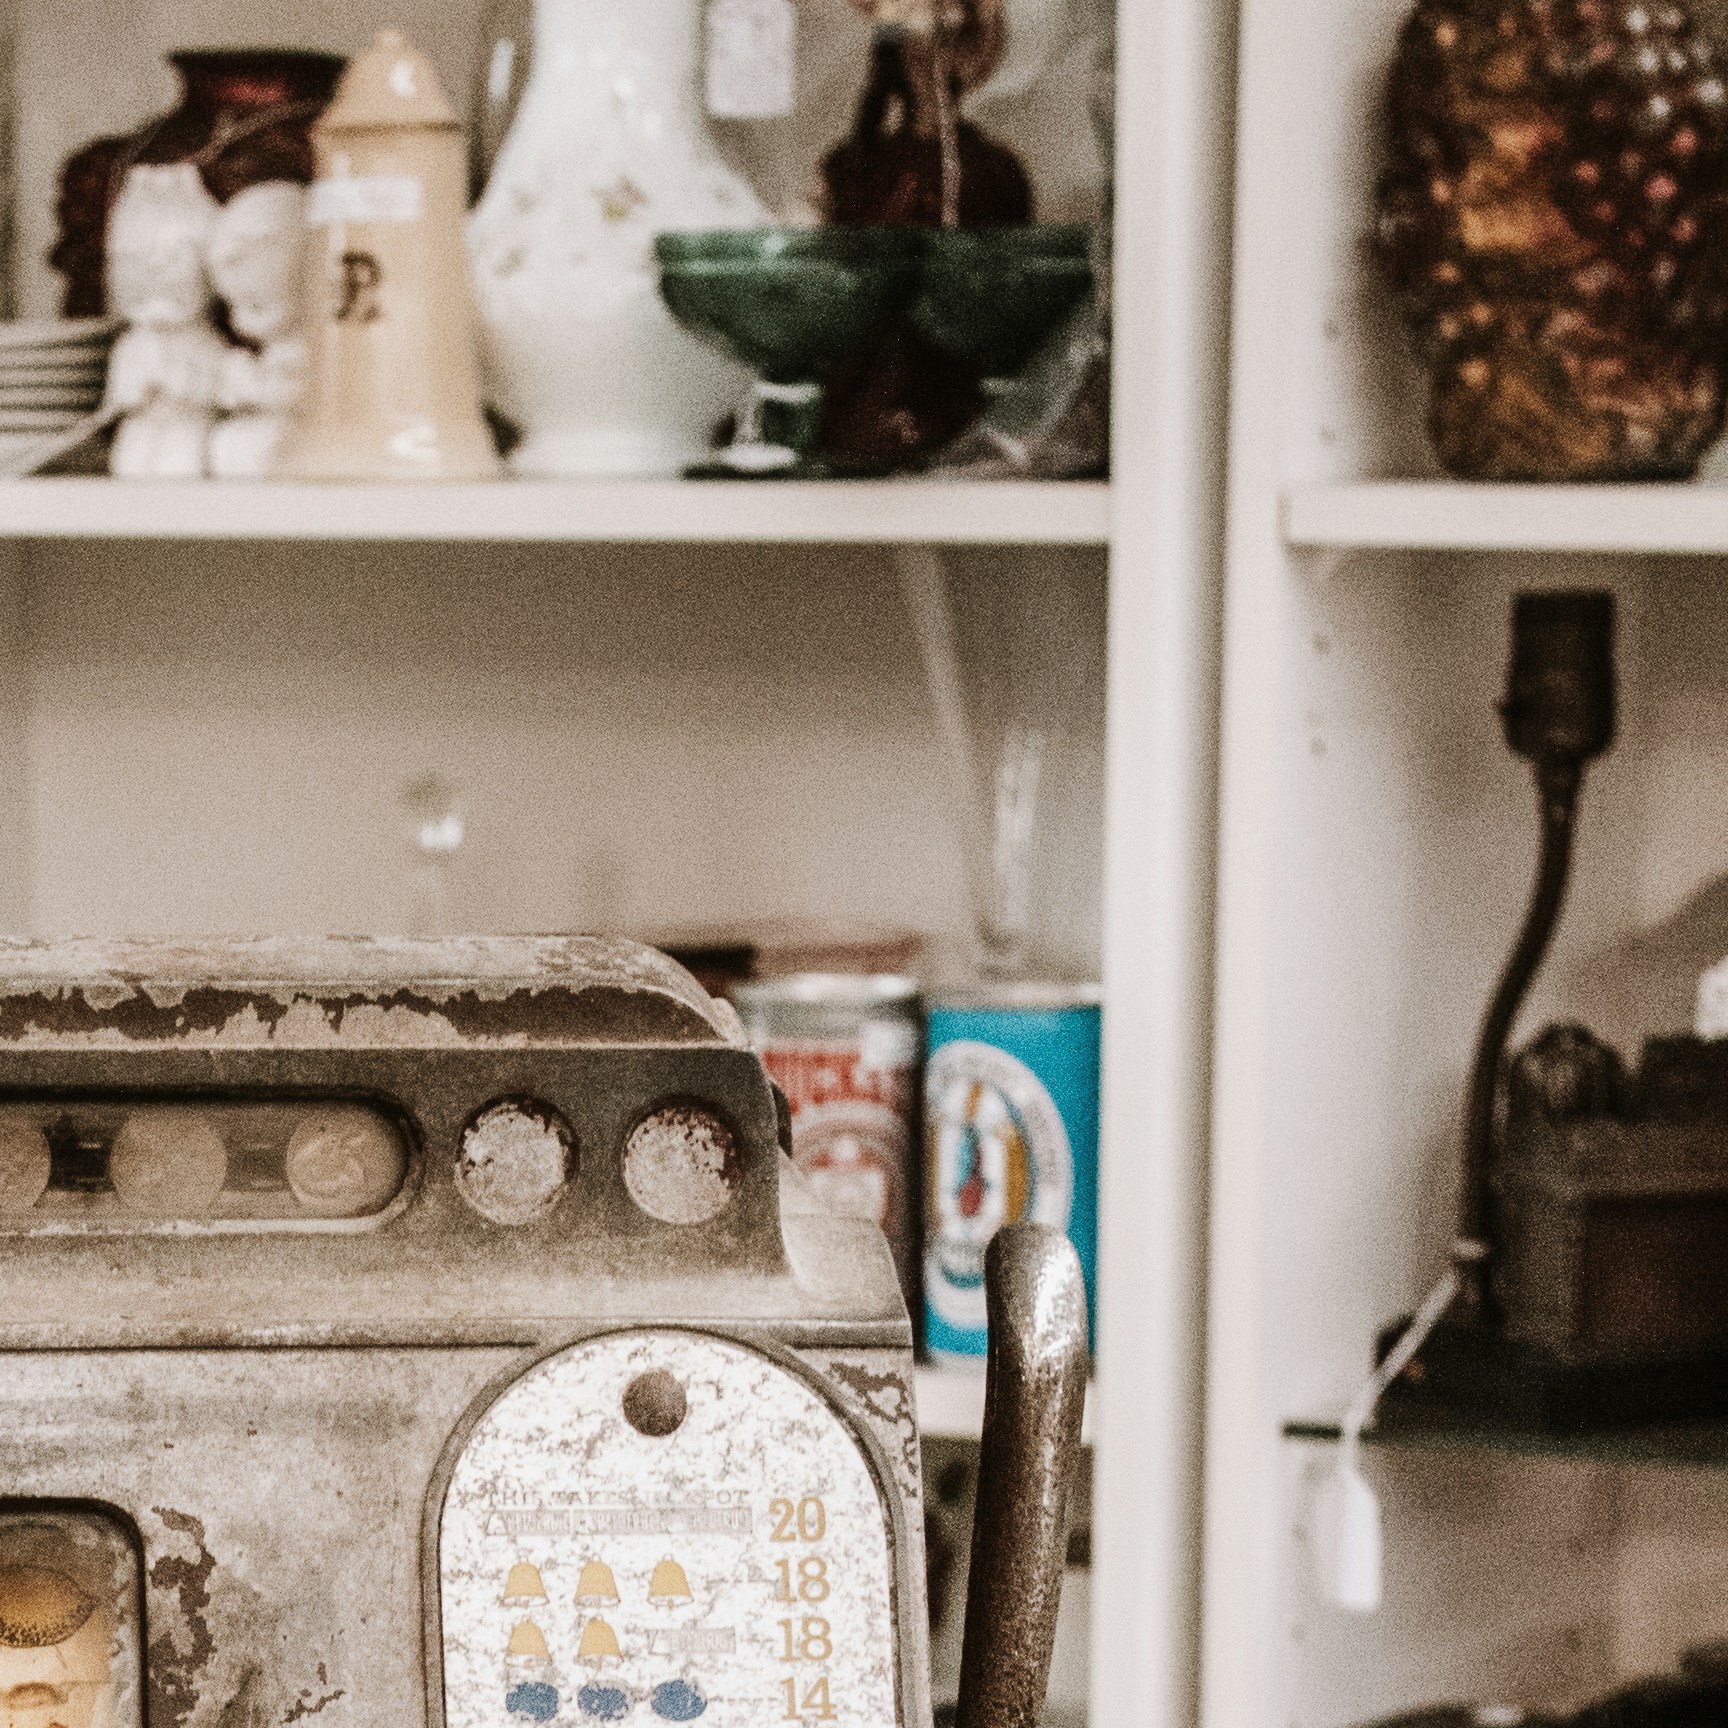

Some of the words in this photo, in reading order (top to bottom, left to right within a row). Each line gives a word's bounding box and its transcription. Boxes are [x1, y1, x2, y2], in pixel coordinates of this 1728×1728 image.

[768, 1497, 827, 1543] 20
[775, 1555, 831, 1604] 18
[777, 1616, 833, 1663] 18
[779, 1676, 838, 1721] 14
